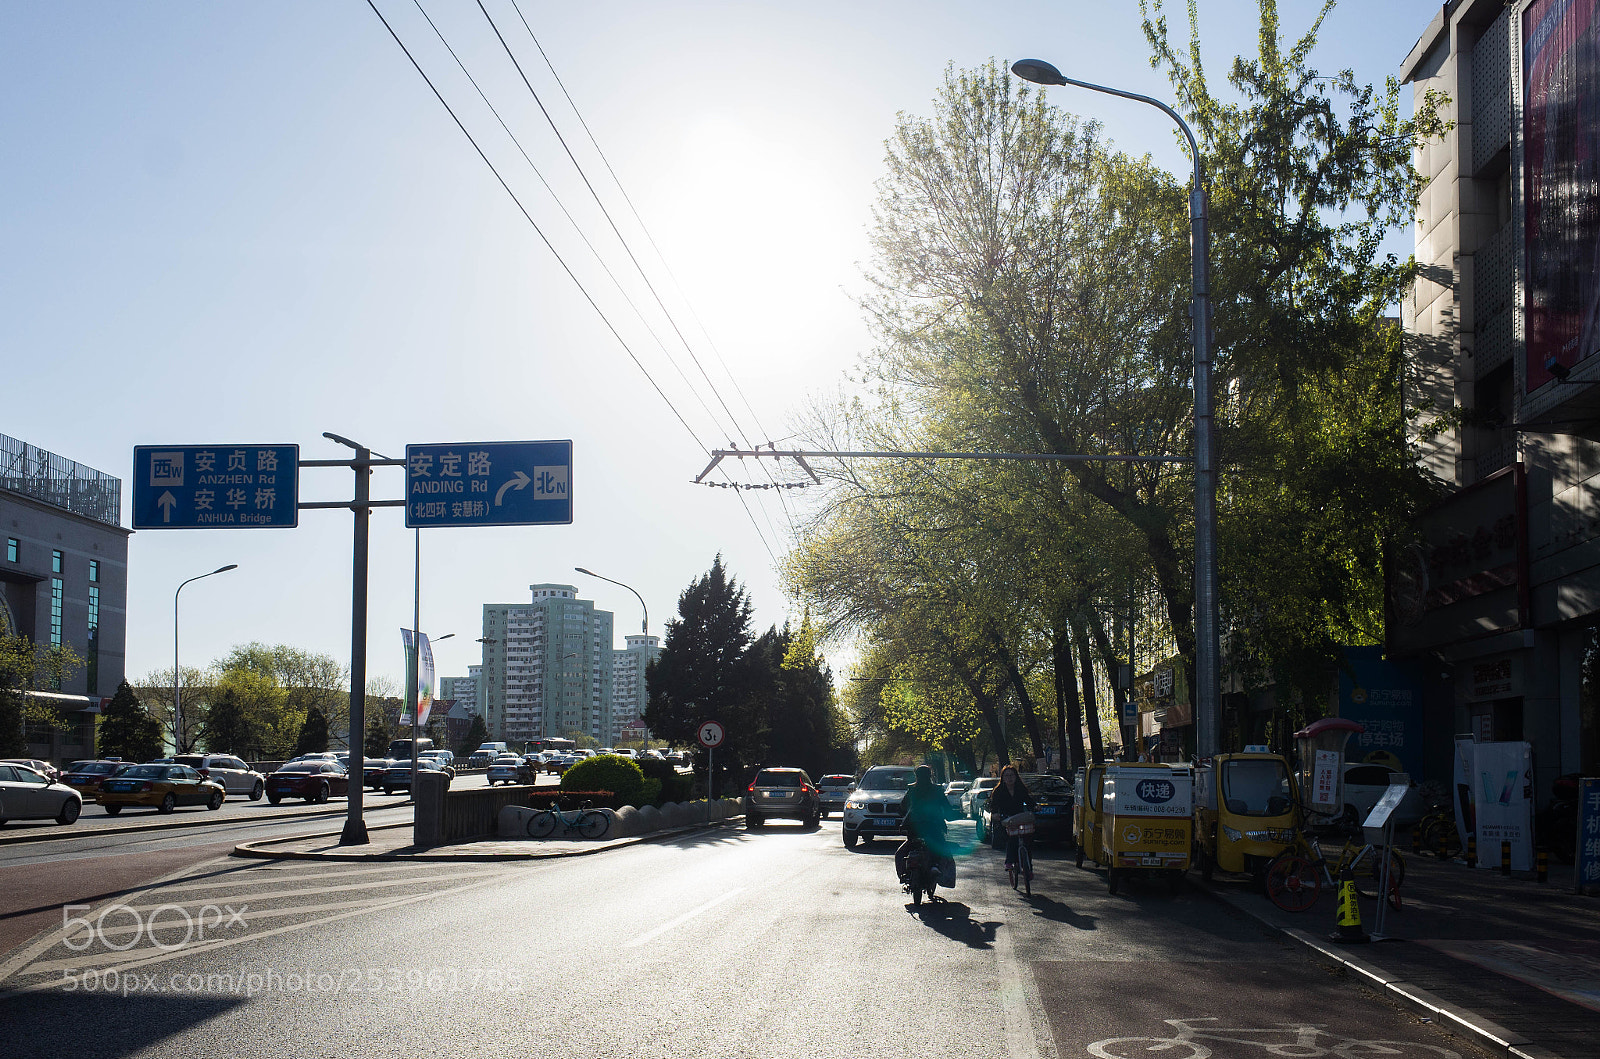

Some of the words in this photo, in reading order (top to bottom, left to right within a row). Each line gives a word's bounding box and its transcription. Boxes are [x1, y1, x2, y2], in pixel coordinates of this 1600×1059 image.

[195, 450, 278, 472] 安贞路
[410, 451, 492, 477] 安定路
[198, 475, 253, 484] ANZHEN
[259, 475, 275, 484] Rd
[412, 481, 464, 494] ANDING
[471, 480, 488, 493] Rd
[194, 488, 276, 510] 安华桥
[197, 513, 234, 523] ANHUA
[240, 513, 272, 524] Bridge
[704, 729, 717, 741] 3t
[1358, 732, 1404, 746] 停车场
[1141, 782, 1170, 799] 快递
[1143, 828, 1186, 840] 苏宁易购
[1583, 792, 1600, 881] 手机维修
[1143, 839, 1185, 848] suning.com
